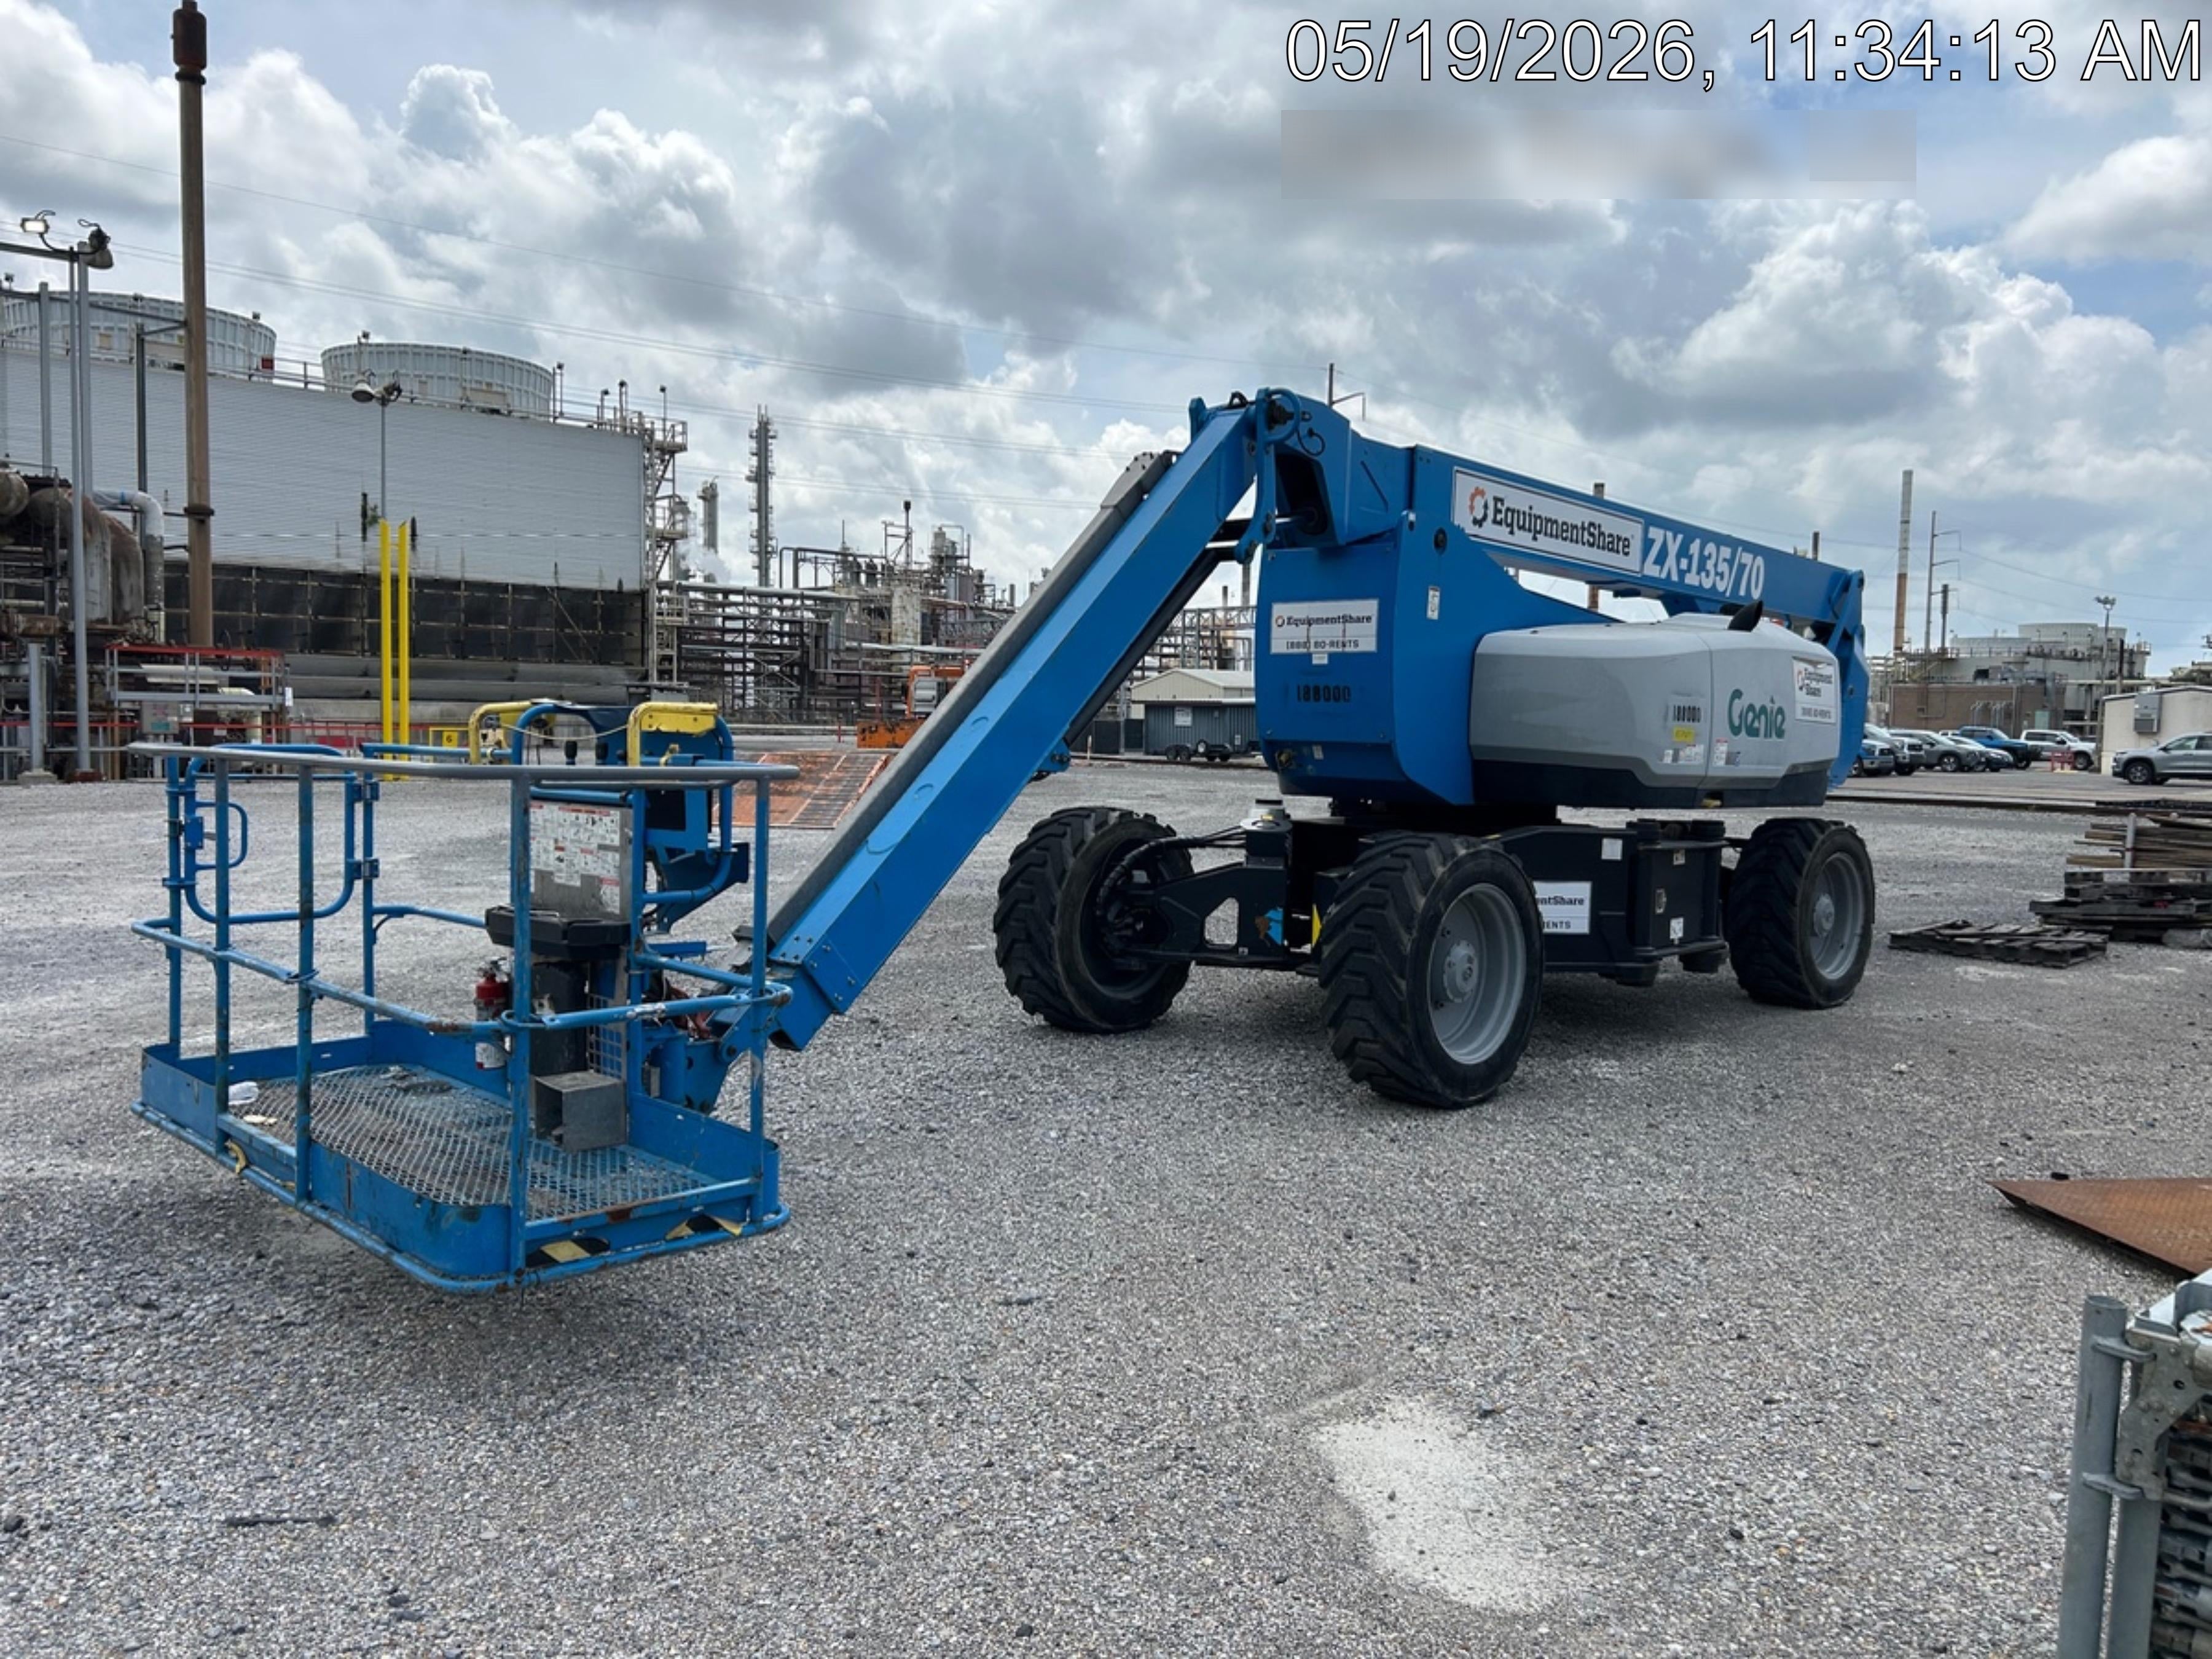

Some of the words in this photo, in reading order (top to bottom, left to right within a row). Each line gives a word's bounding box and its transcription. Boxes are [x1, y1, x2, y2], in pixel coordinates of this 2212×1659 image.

[1492, 495, 1631, 557] EquipmentShare
[1643, 527, 1765, 600] ZX-135/70
[1286, 614, 1372, 627] EquipmentShare
[1297, 684, 1351, 703] 188000
[1727, 688, 1786, 740] Genie
